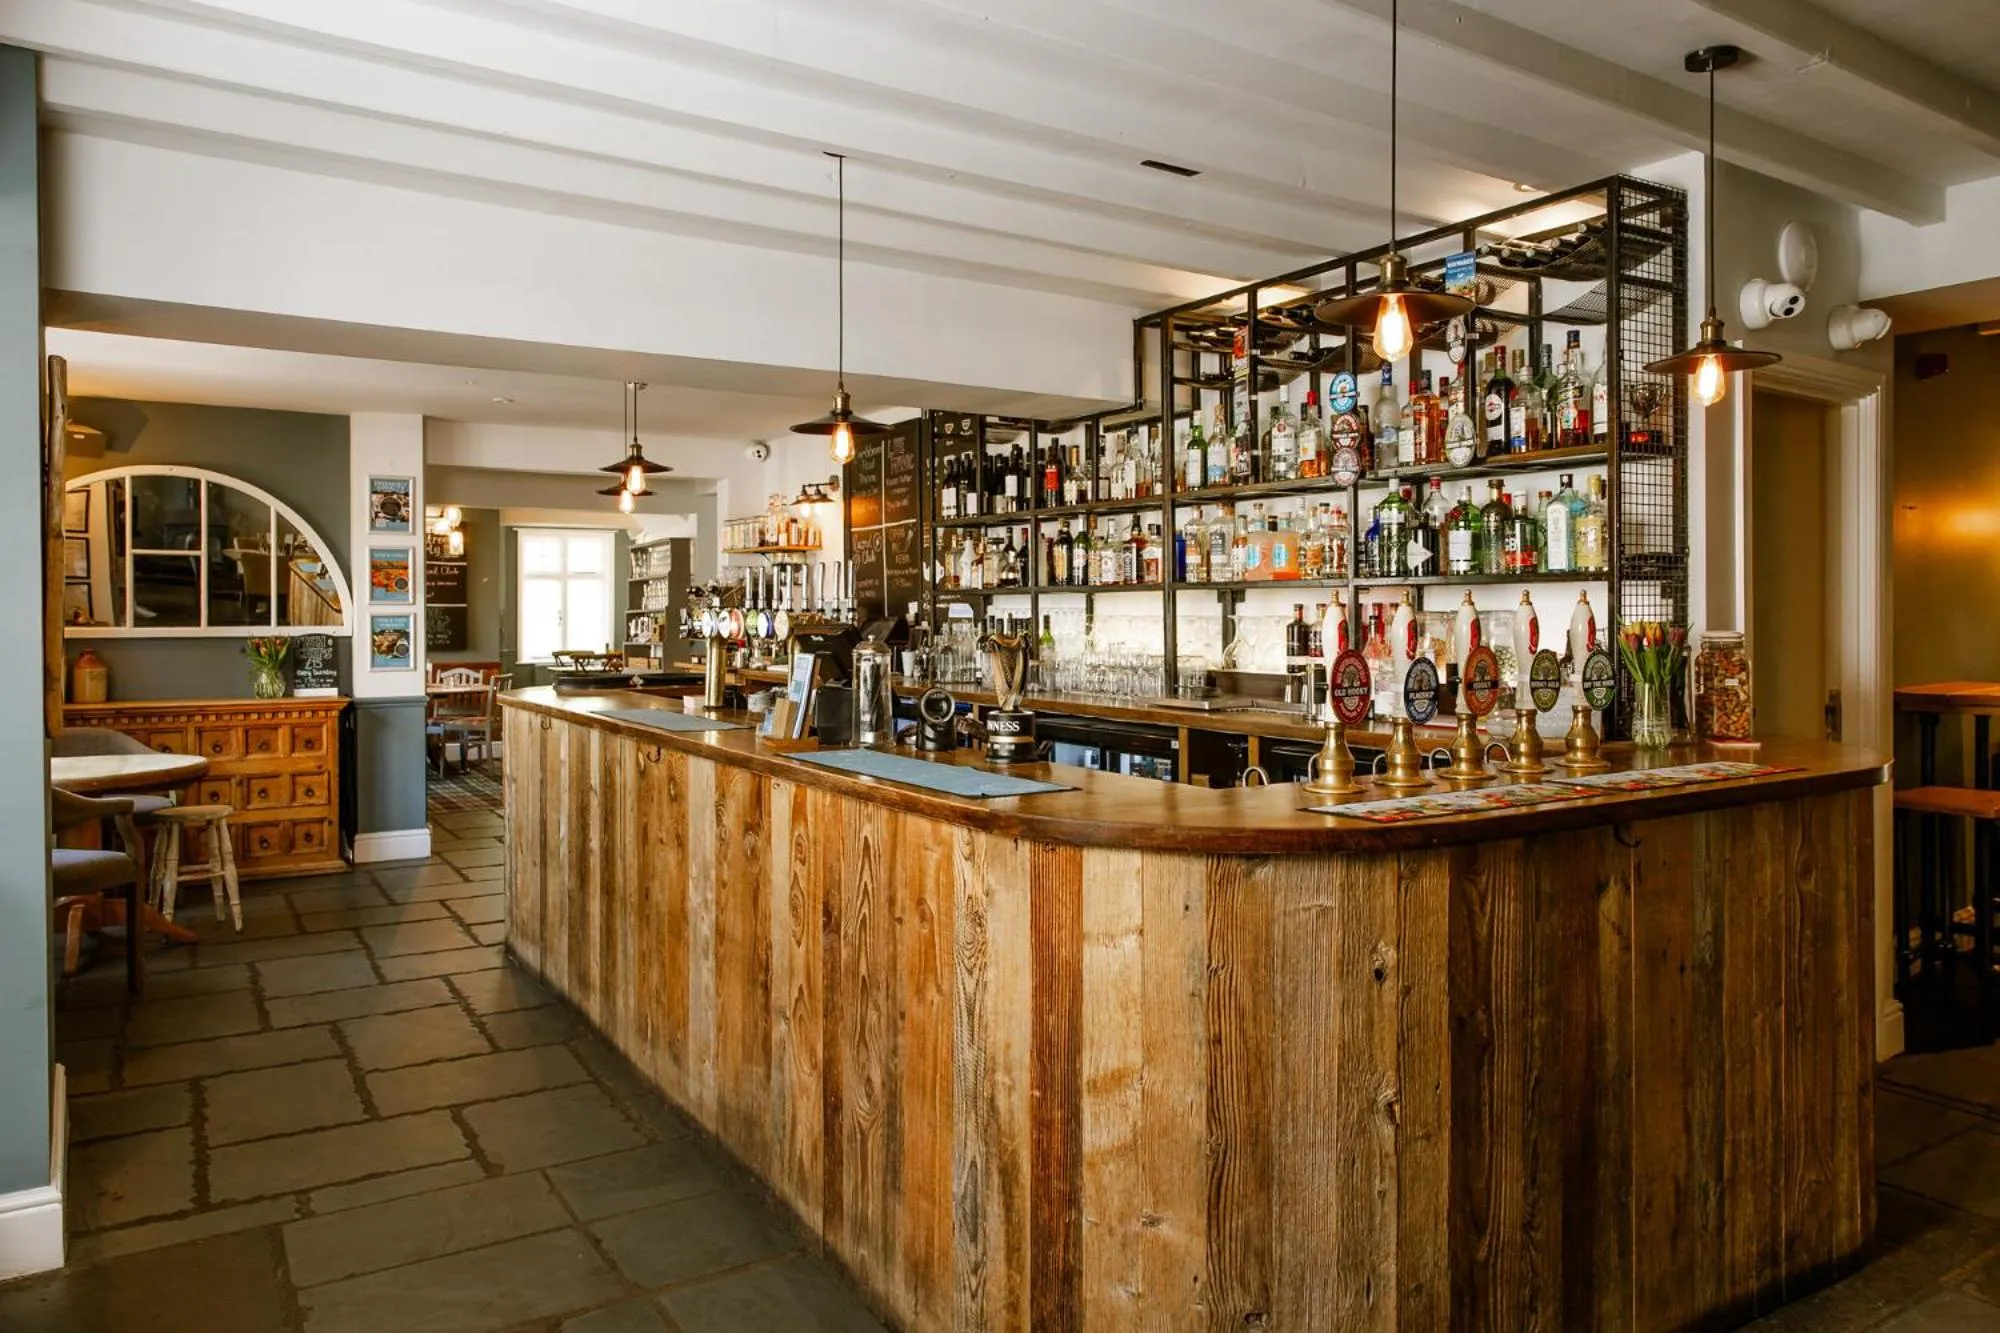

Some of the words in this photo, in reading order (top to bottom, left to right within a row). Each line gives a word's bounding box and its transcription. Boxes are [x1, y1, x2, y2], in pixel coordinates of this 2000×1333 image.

[1334, 687, 1346, 697] OLD
[1347, 686, 1369, 696] HOOKY
[987, 719, 1020, 732] NNESS
